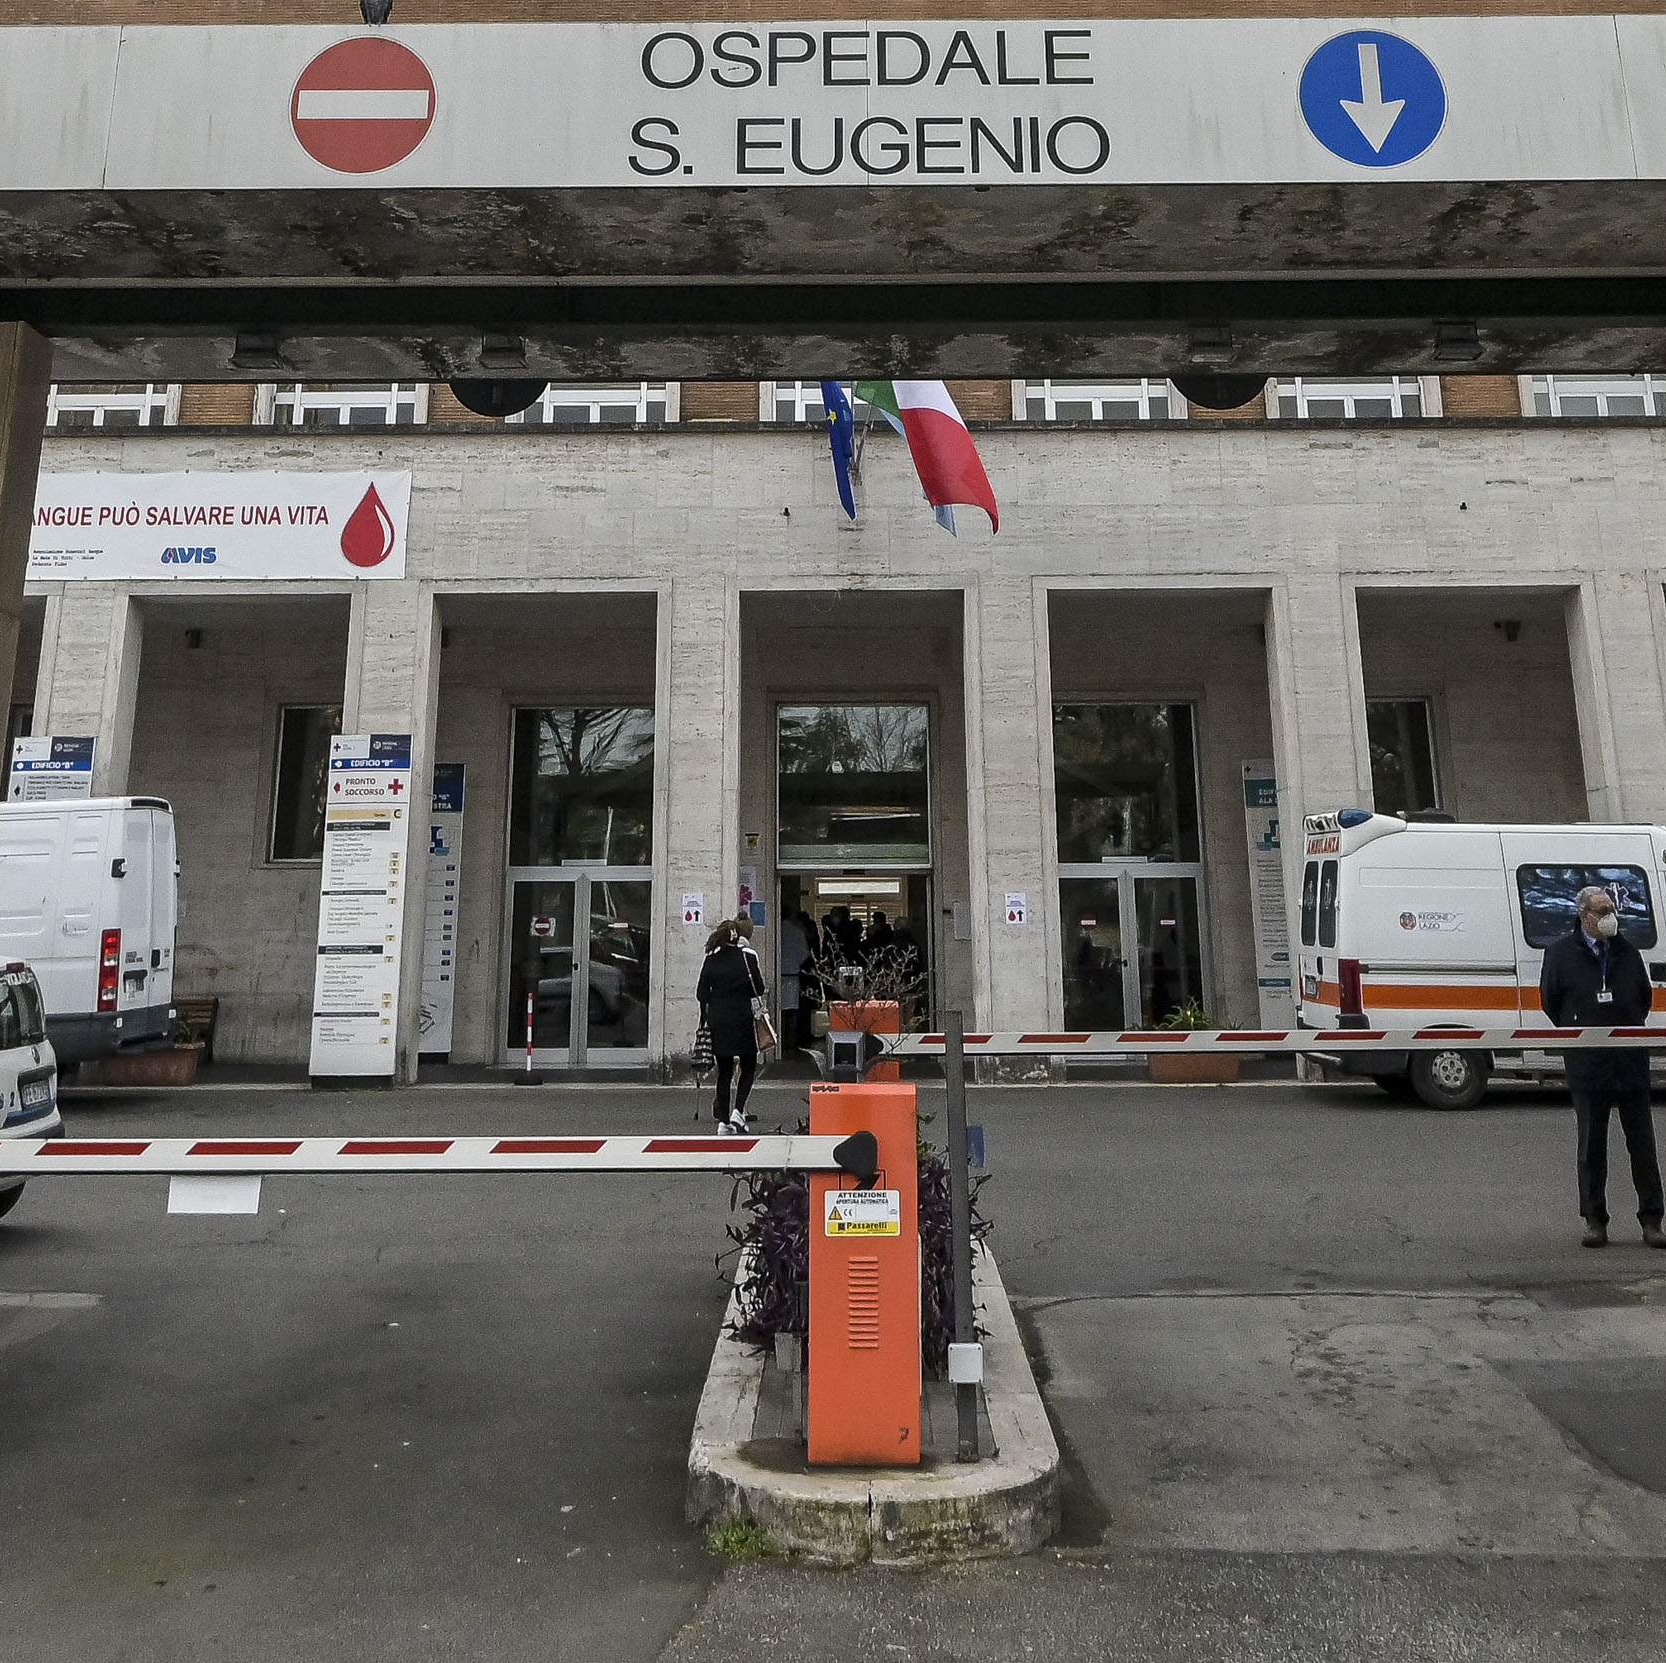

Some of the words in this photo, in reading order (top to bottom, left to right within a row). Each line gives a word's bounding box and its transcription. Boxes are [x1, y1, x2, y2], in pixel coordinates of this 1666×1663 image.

[639, 30, 1095, 88] OSPEDALE
[627, 118, 694, 176] S.
[736, 115, 1111, 175] EUGENIO
[32, 507, 93, 526] NGUE
[98, 501, 140, 526] PUÒ
[145, 506, 235, 526] SALVARE
[241, 506, 281, 525] UNA
[287, 505, 329, 525] VITA
[161, 547, 217, 564] AVIS
[31, 761, 61, 769] EDIFICIO
[345, 777, 377, 786] PRONTO
[344, 788, 385, 796] SOCCORSO
[837, 1191, 887, 1199] ATTENZIONE
[846, 1221, 888, 1230] Passarelli
